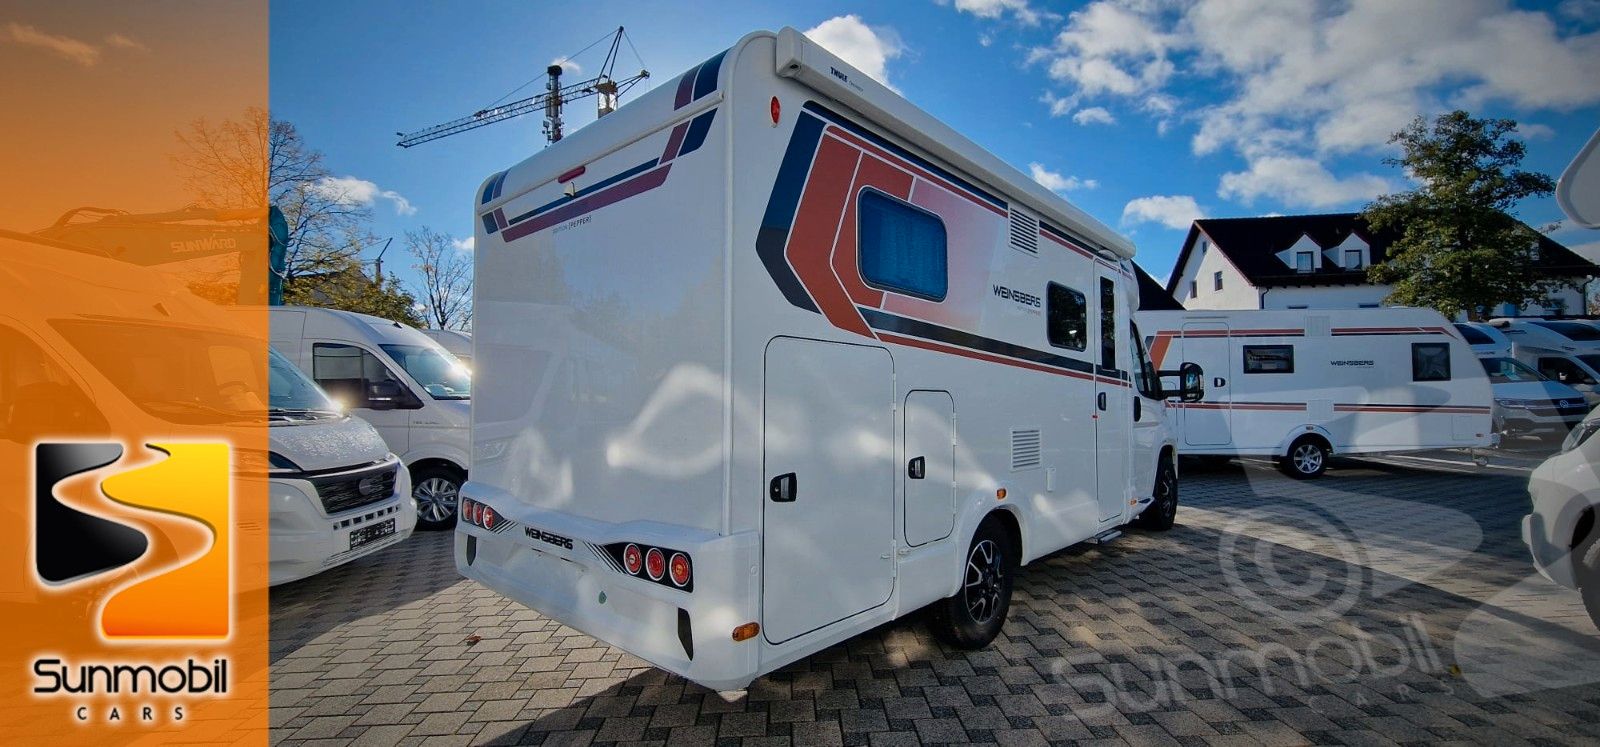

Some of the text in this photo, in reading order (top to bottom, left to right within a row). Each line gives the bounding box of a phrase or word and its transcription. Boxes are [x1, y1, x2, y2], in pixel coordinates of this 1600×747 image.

[170, 238, 237, 253] SUNWARD
[992, 284, 1041, 308] WEINSBERG
[524, 526, 574, 551] WEINSBERG
